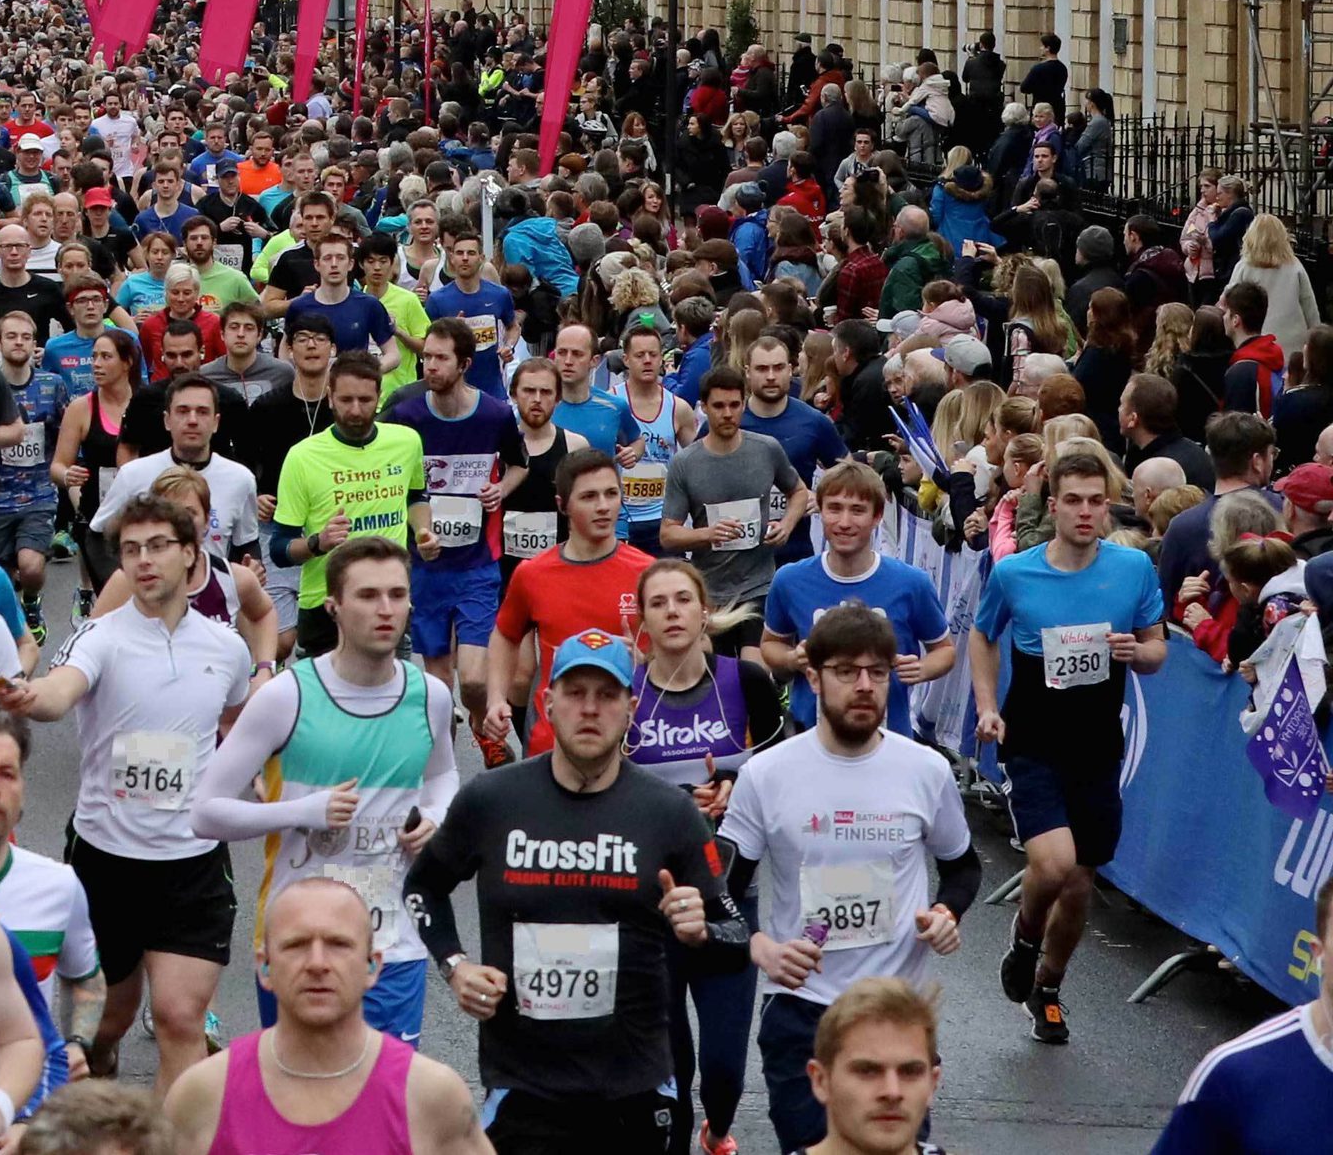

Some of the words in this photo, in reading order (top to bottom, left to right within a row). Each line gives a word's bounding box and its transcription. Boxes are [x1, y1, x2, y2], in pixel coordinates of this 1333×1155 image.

[333, 470, 381, 486] Time
[386, 463, 402, 476] is
[453, 464, 488, 473] CANCER
[453, 473, 492, 482] RESEARC
[333, 486, 404, 506] Precious
[624, 482, 663, 496] 15898
[434, 522, 471, 537] 6058
[512, 535, 548, 551] 1503
[1059, 631, 1095, 646] Vitality
[1054, 653, 1101, 677] 2350
[639, 711, 730, 747] Stroke
[661, 746, 710, 757] association
[124, 766, 184, 793] 5164
[835, 826, 906, 842] FINISHER
[505, 829, 639, 874] CrossFit
[816, 899, 882, 931] 3897
[528, 968, 599, 998] 4978
